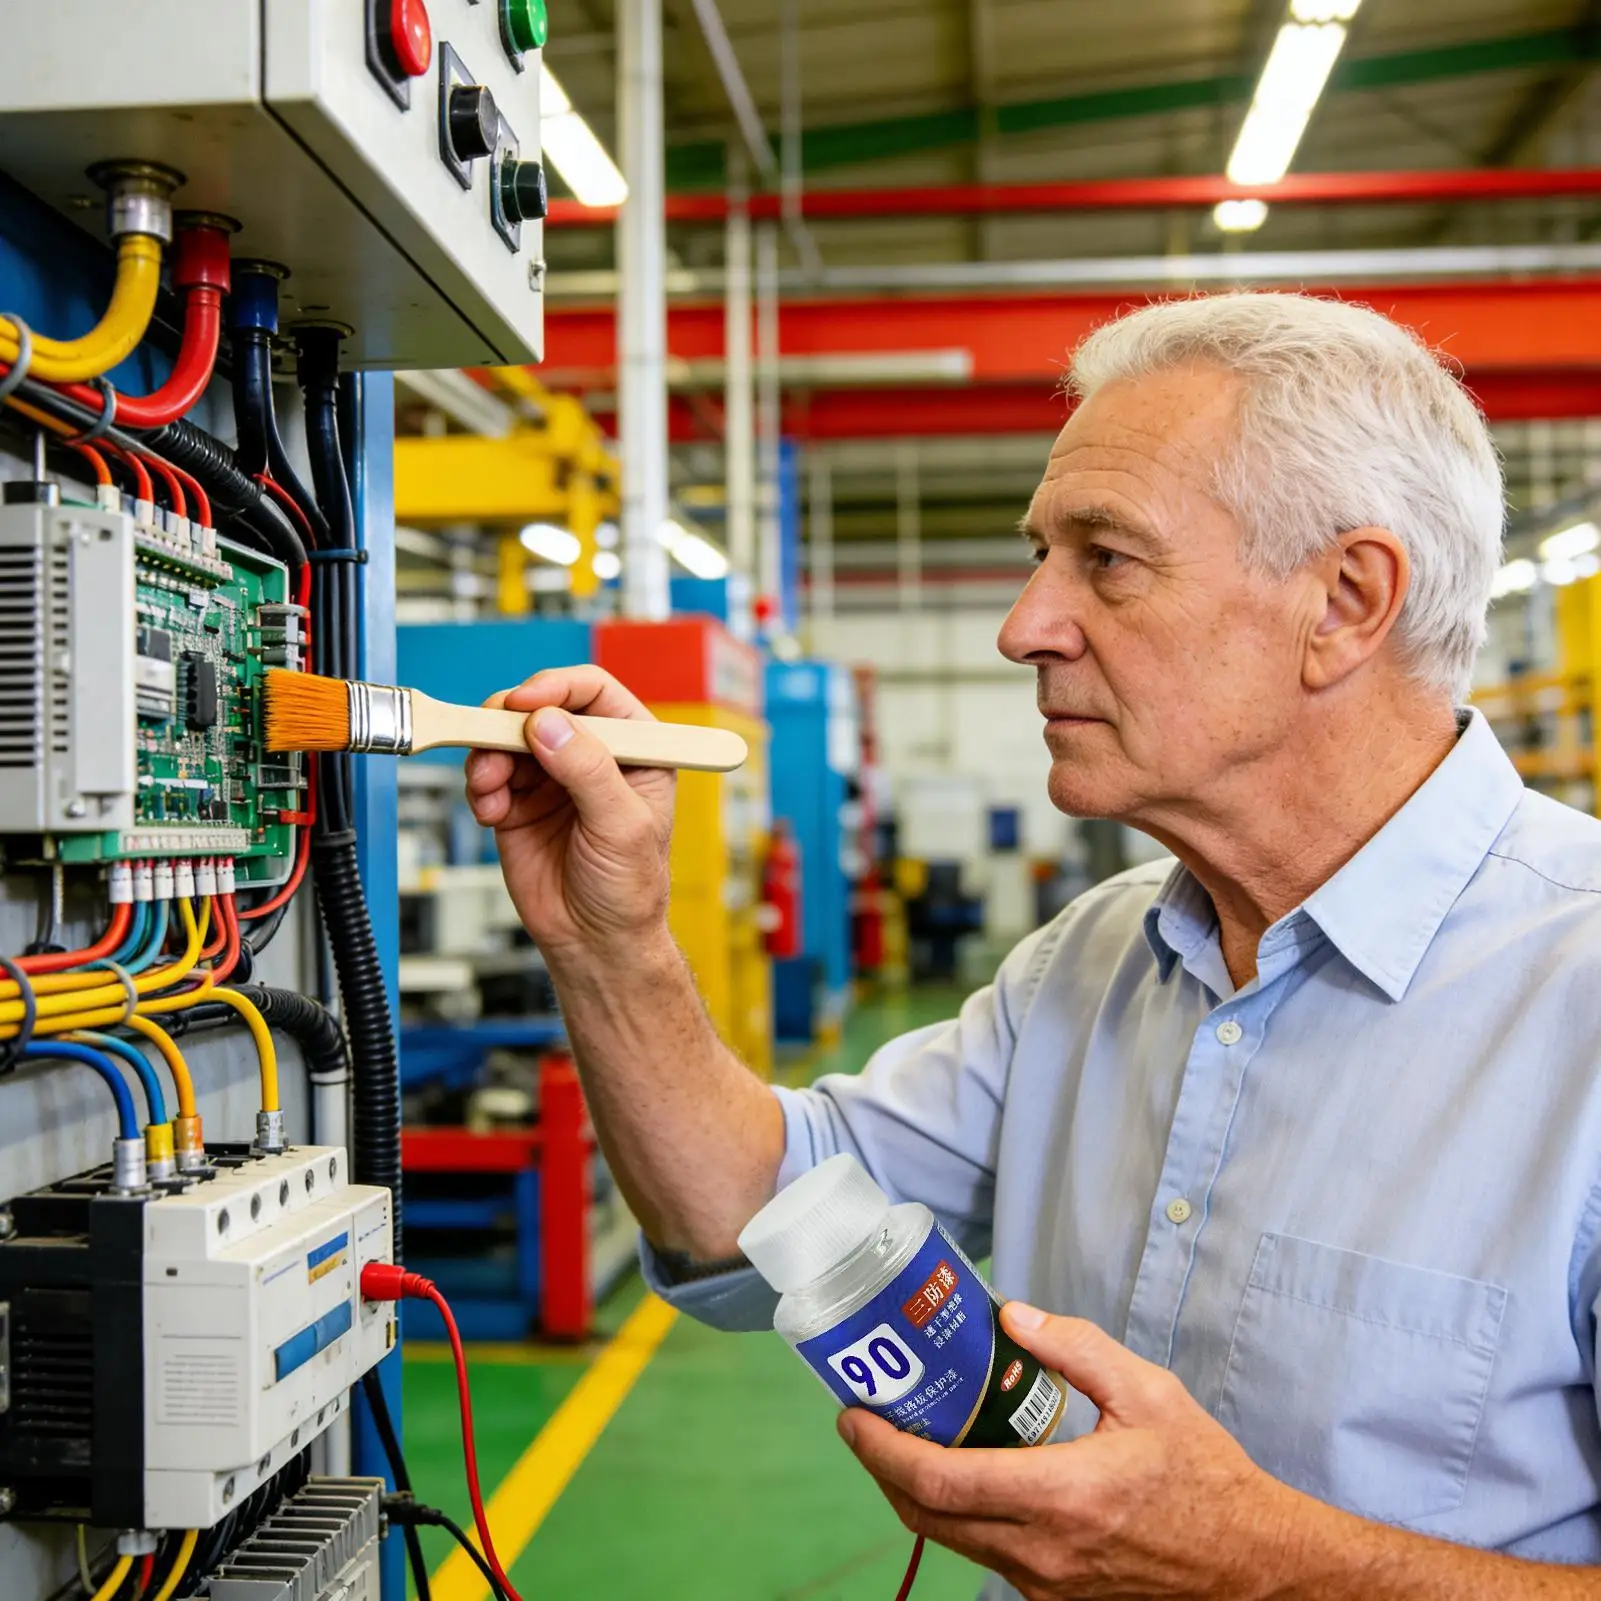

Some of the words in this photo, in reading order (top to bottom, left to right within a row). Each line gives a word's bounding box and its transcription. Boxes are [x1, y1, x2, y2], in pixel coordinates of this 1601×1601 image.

[909, 1265, 955, 1324] 三防漆
[841, 1337, 911, 1397] 90
[1002, 1360, 1023, 1390] RoHS
